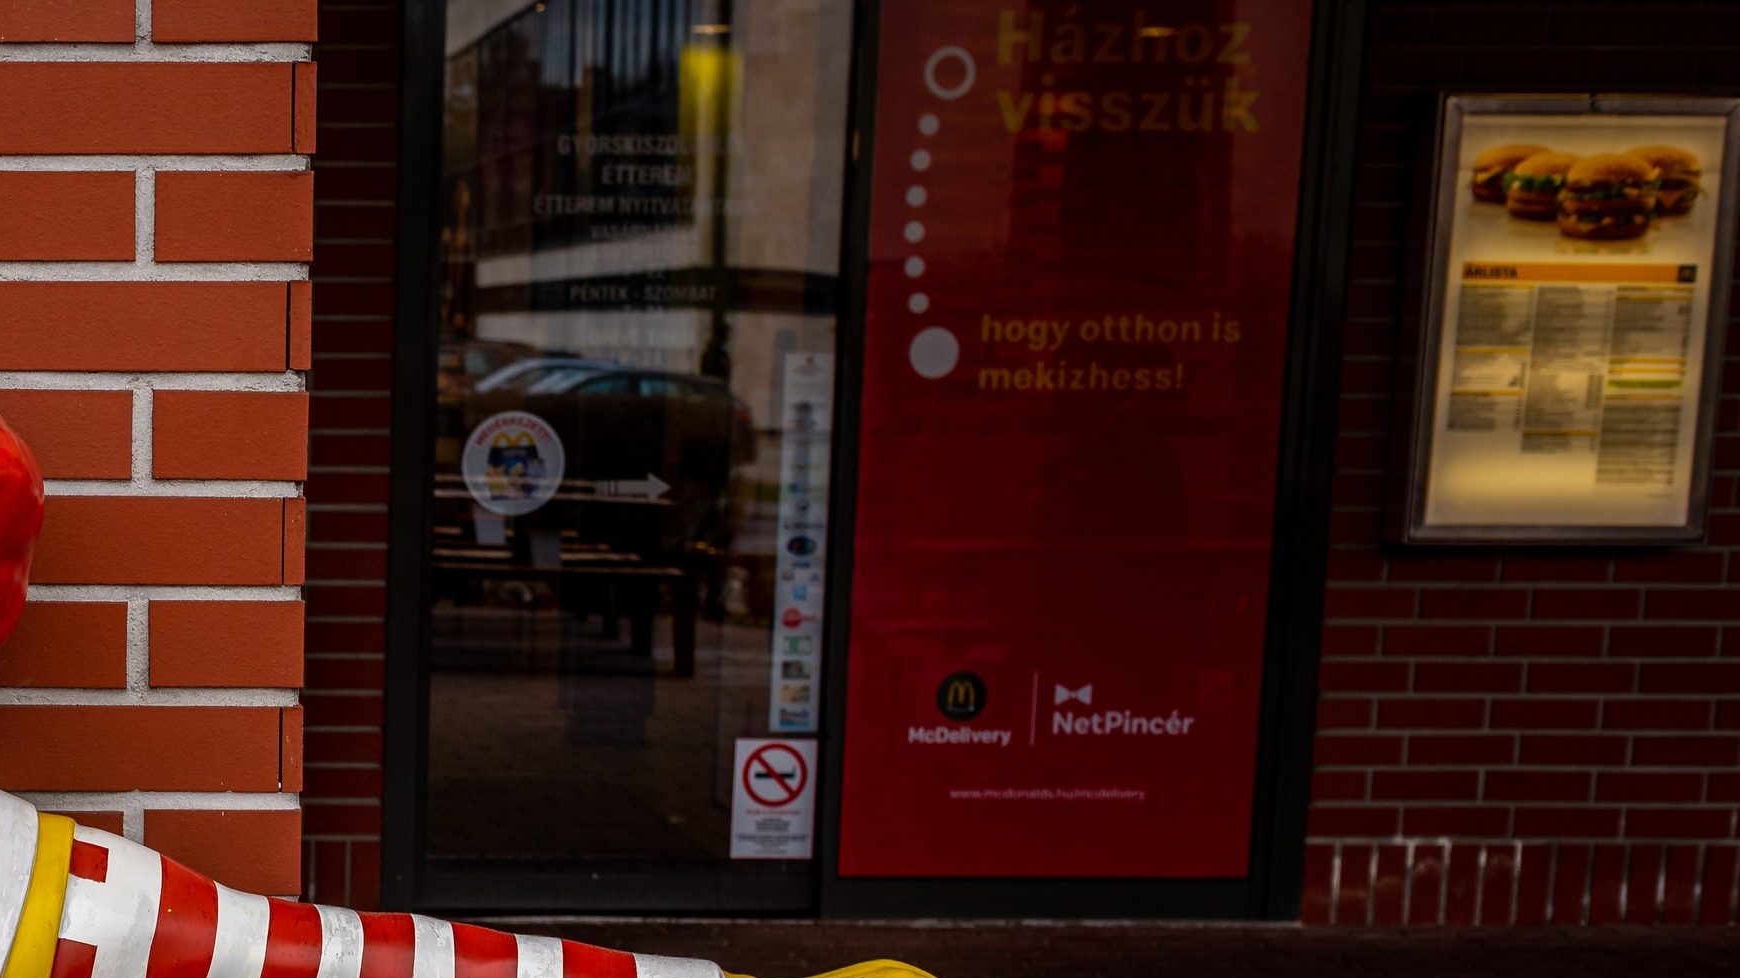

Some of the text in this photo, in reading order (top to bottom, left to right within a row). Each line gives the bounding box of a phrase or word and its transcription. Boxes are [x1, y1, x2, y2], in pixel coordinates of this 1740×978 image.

[997, 7, 1251, 64] Házhoz
[996, 75, 1261, 133] visszük
[569, 282, 628, 302] PÉNTEK
[981, 311, 1243, 352] hogy otthon is
[978, 360, 1184, 391] mekizhess!
[907, 725, 1012, 747] McDelivery
[1051, 708, 1196, 736] NetPincér
